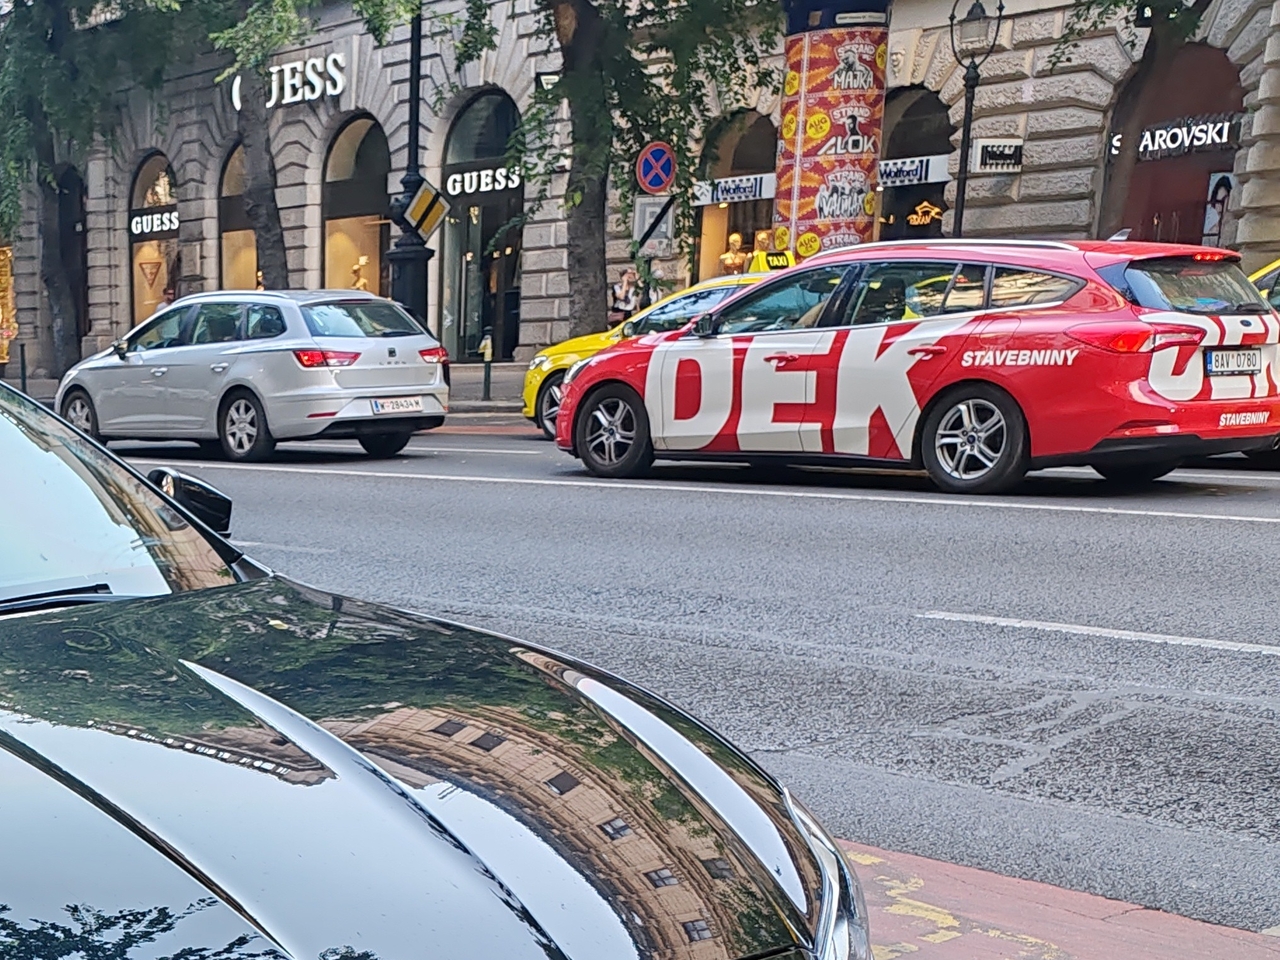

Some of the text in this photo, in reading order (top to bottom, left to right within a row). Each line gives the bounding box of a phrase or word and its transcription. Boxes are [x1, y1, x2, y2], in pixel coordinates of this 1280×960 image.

[833, 71, 874, 90] MAJKA
[832, 106, 870, 120] STRAND
[817, 135, 877, 155] ALOK
[1111, 122, 1230, 154] SAROVSKI
[447, 166, 520, 195] GUESS
[131, 211, 179, 234] GUESS
[767, 255, 788, 267] TAXI
[961, 349, 1079, 367] STAVEBNINY
[1236, 353, 1256, 368] 0780
[644, 313, 986, 460] DEK
[1220, 411, 1270, 426] STAVEBNINY
